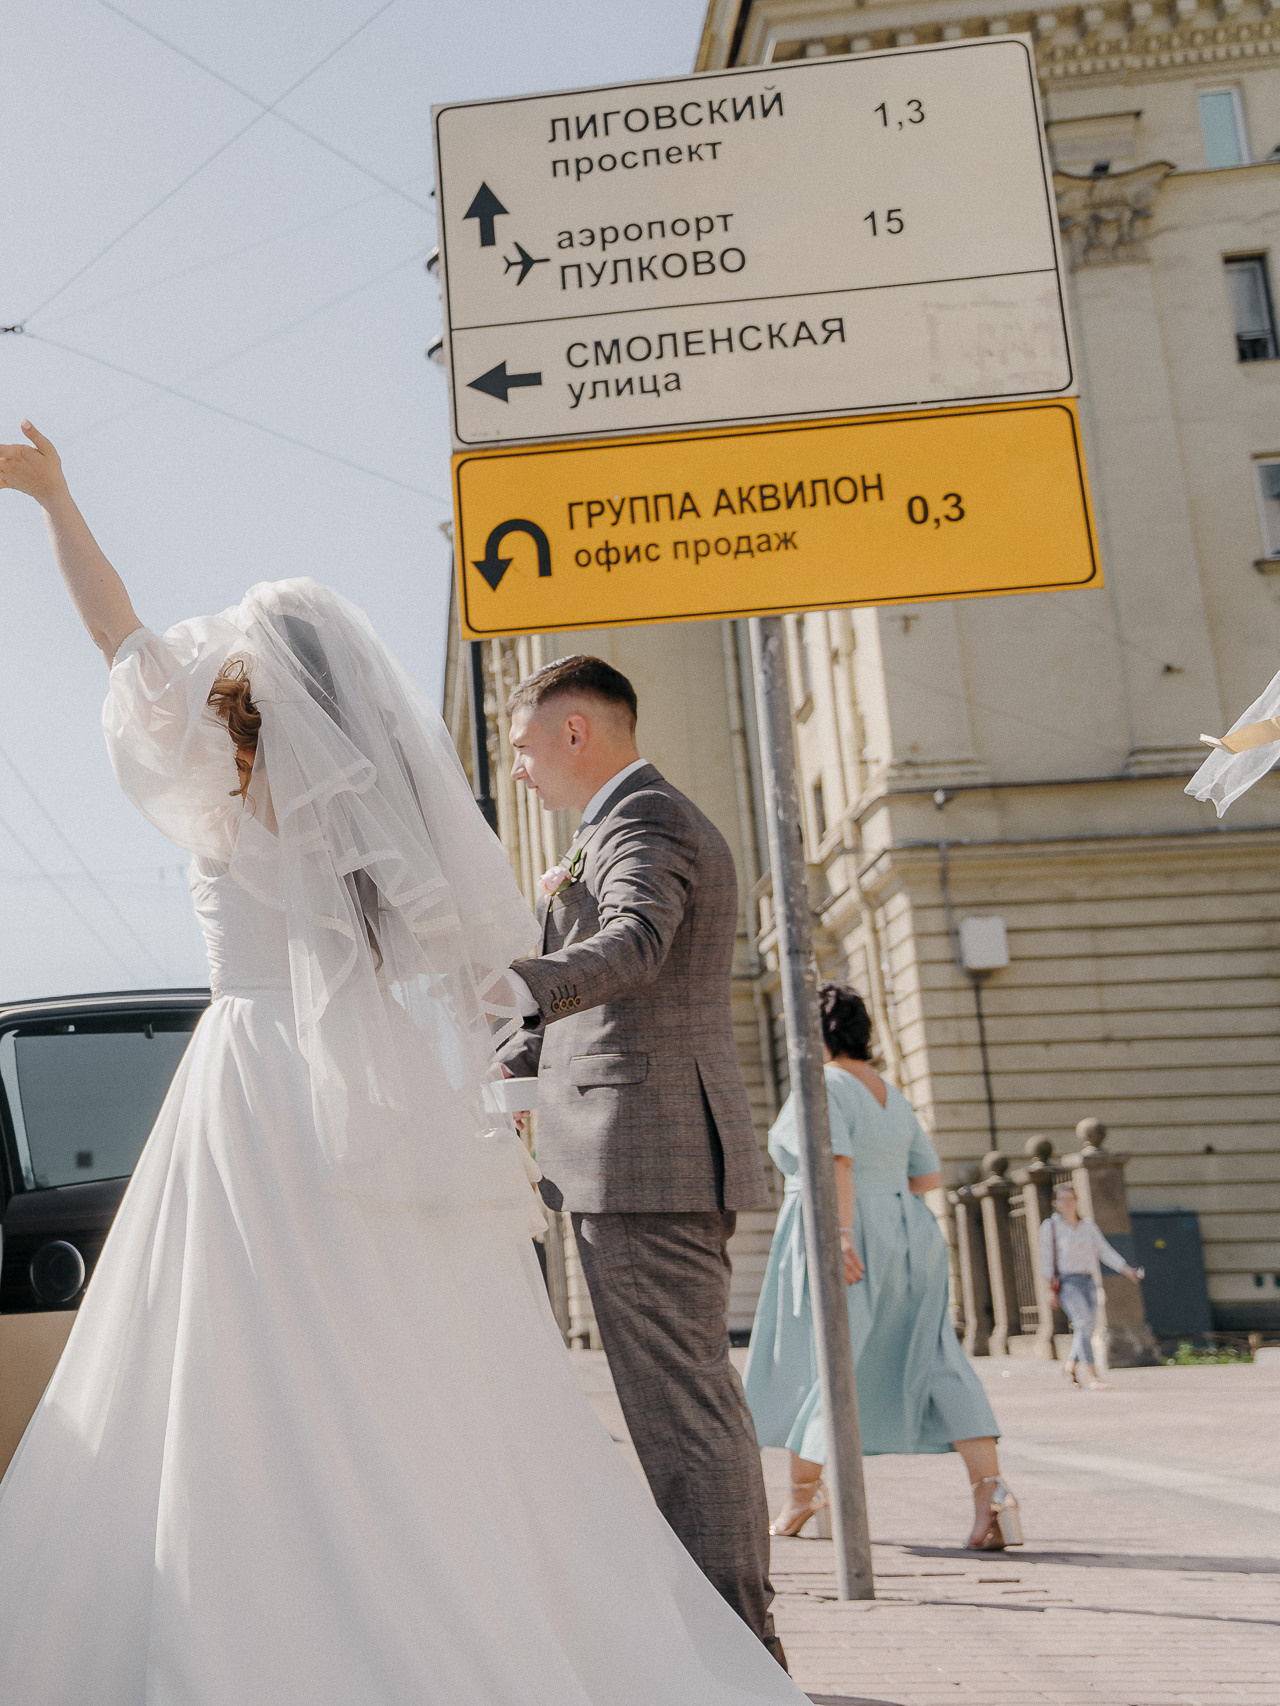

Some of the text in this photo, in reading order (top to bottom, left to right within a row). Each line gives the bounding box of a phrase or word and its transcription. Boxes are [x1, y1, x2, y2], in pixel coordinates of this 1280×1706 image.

[547, 85, 784, 143] ЛИГОВСКИЙ
[873, 98, 926, 132] 1,3
[551, 141, 723, 181] проспект
[557, 212, 734, 252] аэропорт
[863, 208, 906, 238] 15
[560, 247, 747, 291] ПУЛКОВО
[566, 317, 847, 369] СМОЛЕНСКАЯ
[567, 371, 682, 409] улица
[567, 473, 885, 531] ГРУППА АКВИЛОН
[907, 492, 967, 530] 0,3
[574, 531, 799, 573] офис продаж
